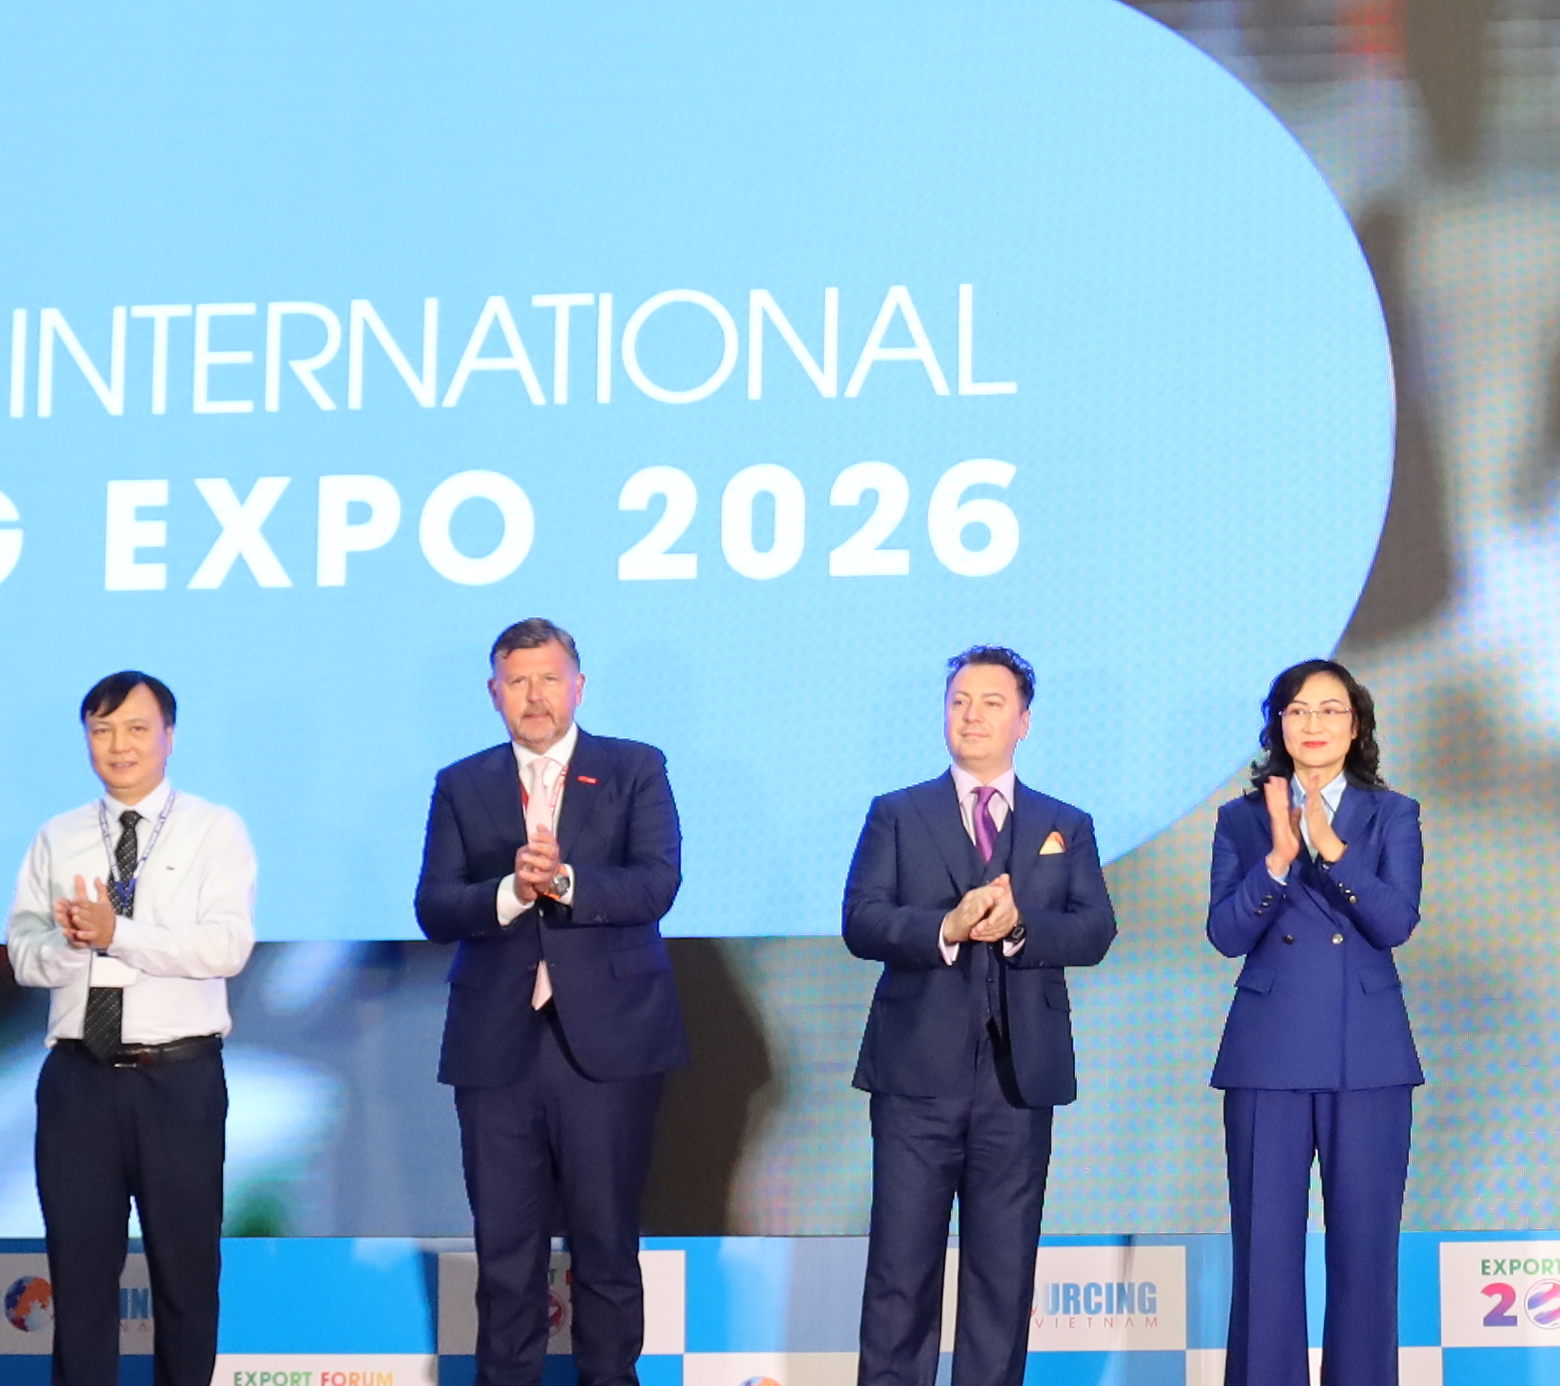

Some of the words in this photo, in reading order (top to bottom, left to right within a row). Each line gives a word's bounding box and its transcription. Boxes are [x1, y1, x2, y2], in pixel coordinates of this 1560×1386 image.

[9, 283, 1017, 419] INTERNATIONAL
[103, 469, 536, 592] EXPO
[617, 458, 1020, 581] 2026
[1033, 1315, 1159, 1329] VIETNAM
